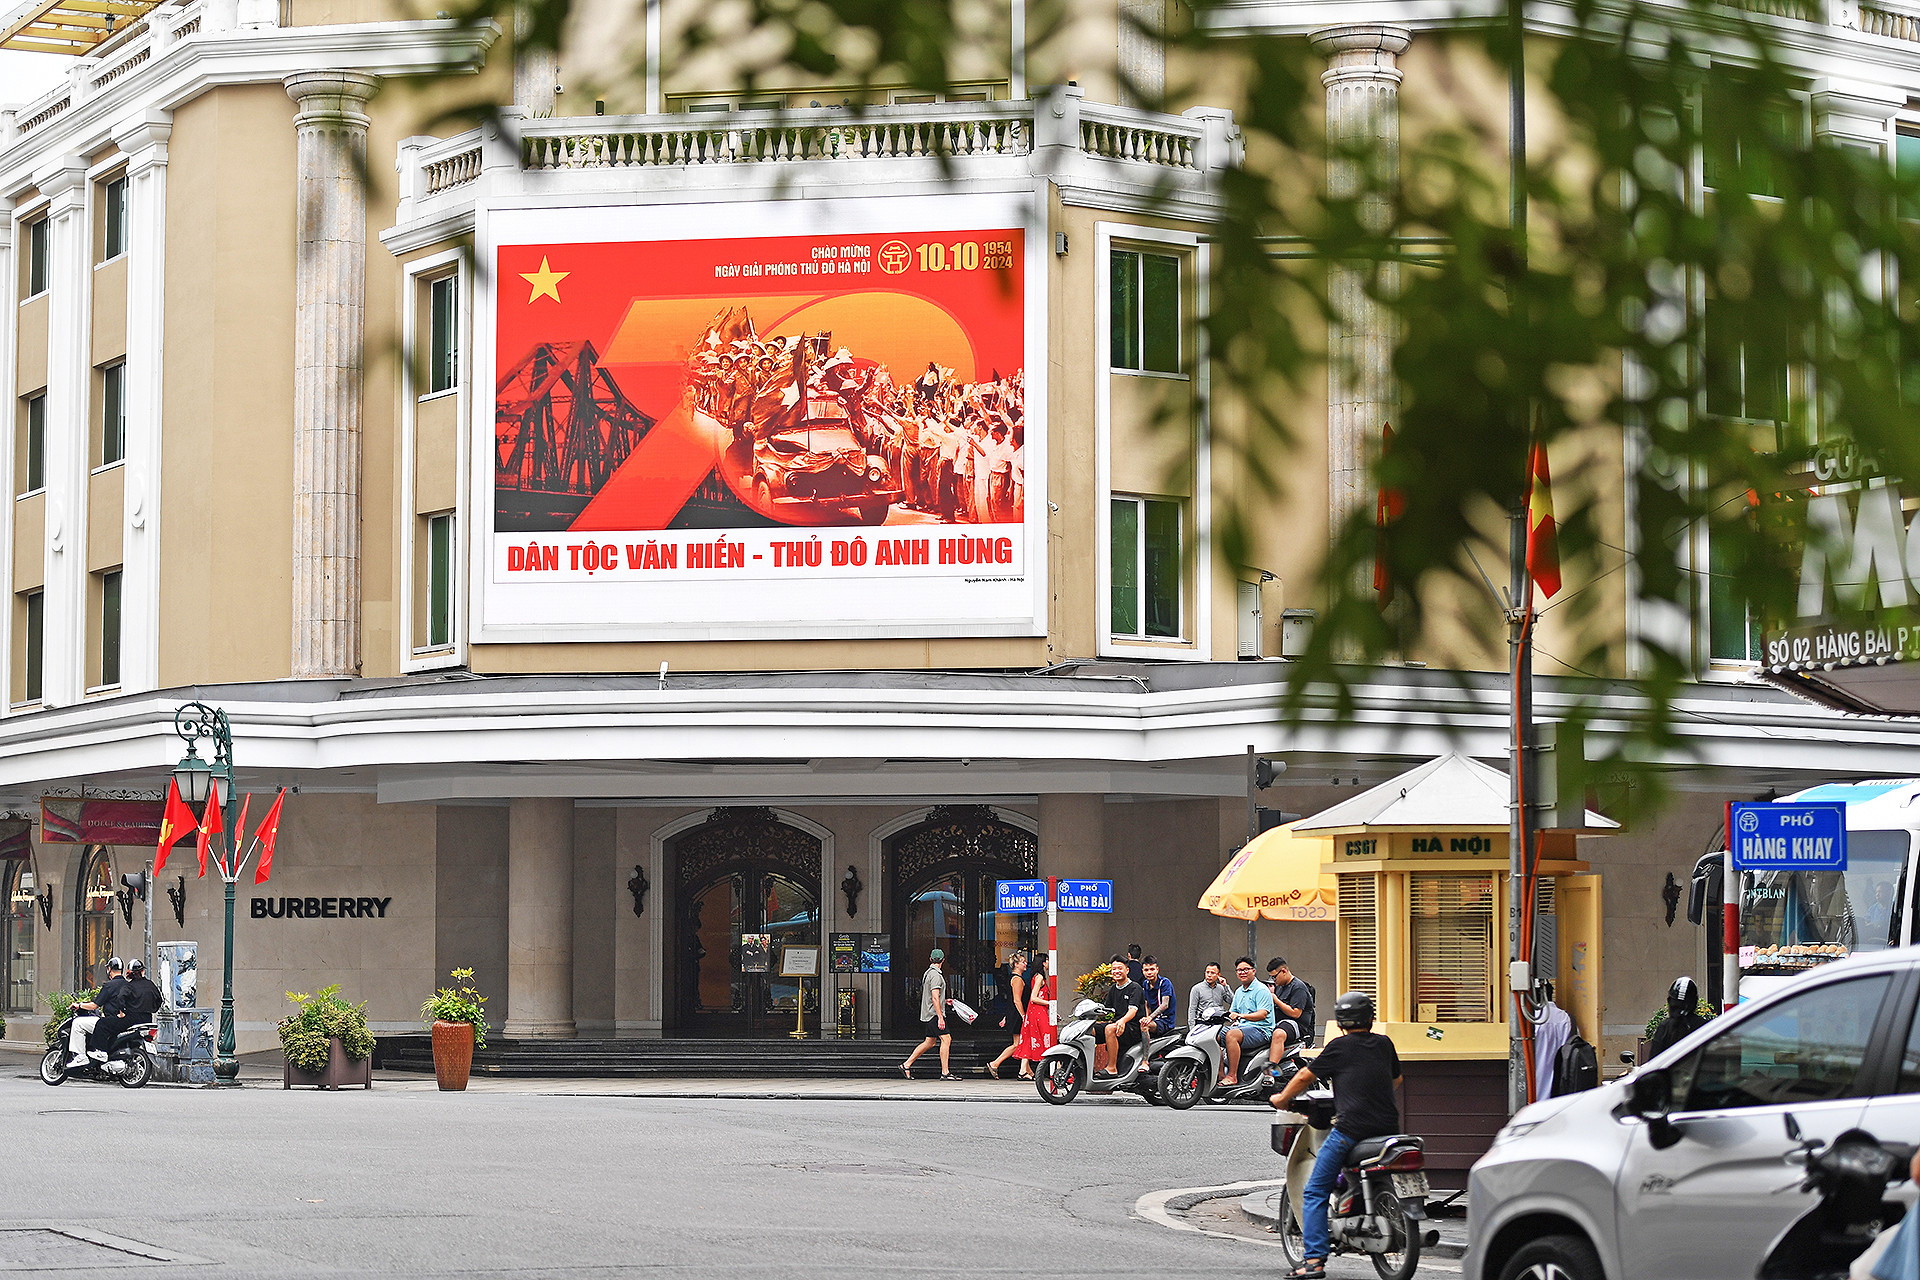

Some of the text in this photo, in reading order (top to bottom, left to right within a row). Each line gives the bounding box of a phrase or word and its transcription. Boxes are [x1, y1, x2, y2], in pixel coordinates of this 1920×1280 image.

[811, 243, 871, 259] CHÀO MỪNG
[915, 241, 979, 272] 10.10
[982, 241, 1013, 255] 1954
[715, 258, 871, 278] NGÀY GIẢI PHÓNG THỦ ĐÔ HÀ NỘI
[982, 255, 1014, 270] 2024
[507, 541, 559, 572] DÂN
[567, 540, 618, 576] TỘC
[625, 539, 678, 570] VĂN
[686, 533, 745, 569] HIẾN
[770, 534, 822, 568] THỦ
[830, 535, 868, 567] ĐÔ
[875, 539, 930, 566] ANH
[938, 534, 1013, 565] HÙNG
[1768, 631, 1790, 665] SỐ
[1793, 637, 1811, 662] 02
[1816, 628, 1861, 660] HÀNG
[1780, 810, 1815, 827] PHỐ
[1345, 839, 1378, 856] CSGT
[1411, 835, 1491, 855] HÀ NỘI
[1742, 833, 1834, 860] HÀNG KHAY
[1018, 881, 1036, 892] PHỐ
[1080, 881, 1098, 892] PHỐ
[250, 897, 392, 919] BURBERRY
[1001, 892, 1044, 908] TRÀNG TIẾN
[1061, 892, 1108, 908] HÀNG BÀI
[1246, 895, 1291, 908] LPBank
